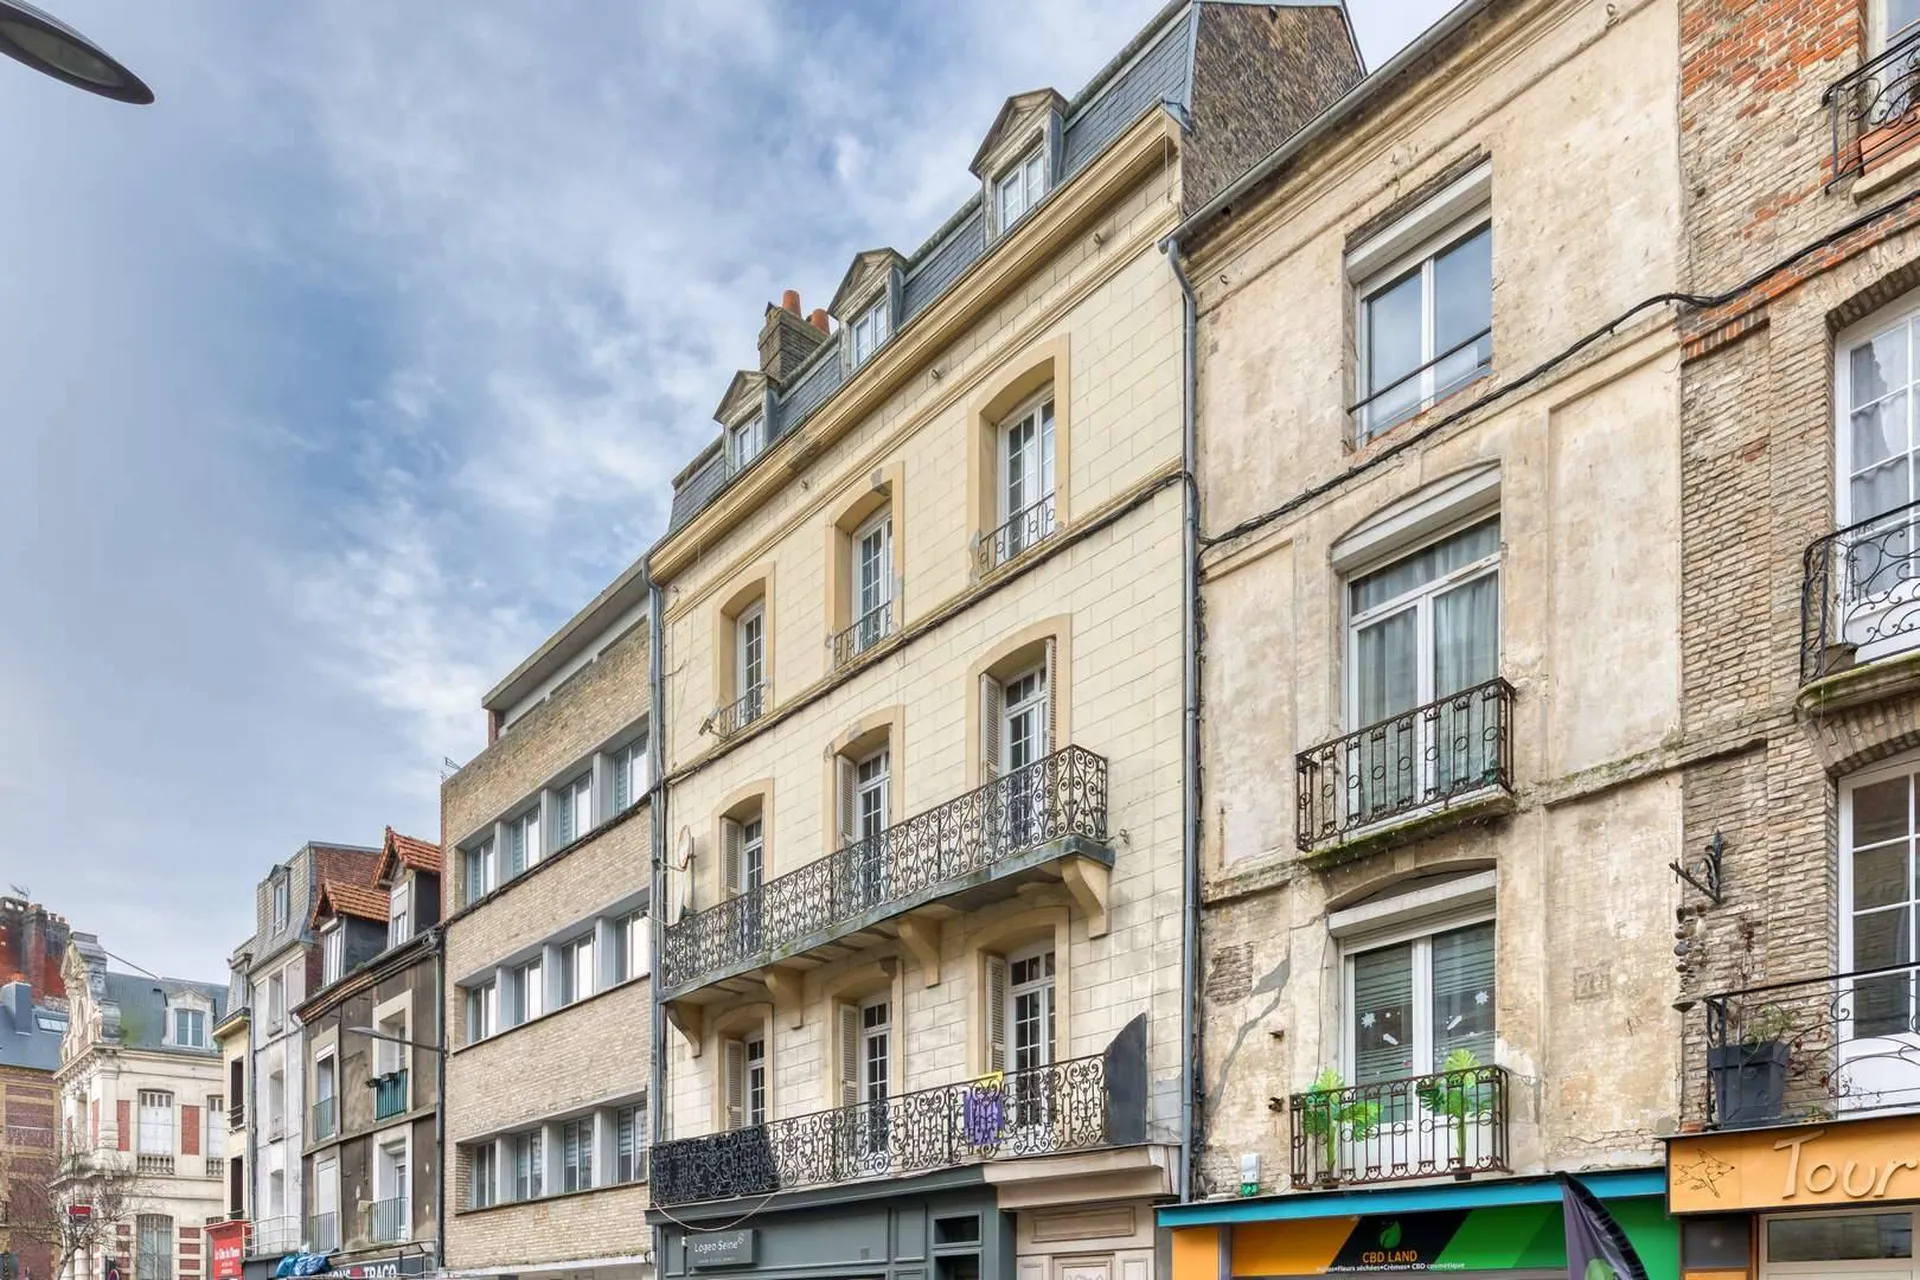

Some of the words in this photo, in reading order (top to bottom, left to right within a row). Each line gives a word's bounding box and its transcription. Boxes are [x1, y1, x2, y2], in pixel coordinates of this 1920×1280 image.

[1773, 1129, 1919, 1199] Tour
[1362, 1251, 1385, 1263] CBD
[1388, 1250, 1418, 1263] LAND
